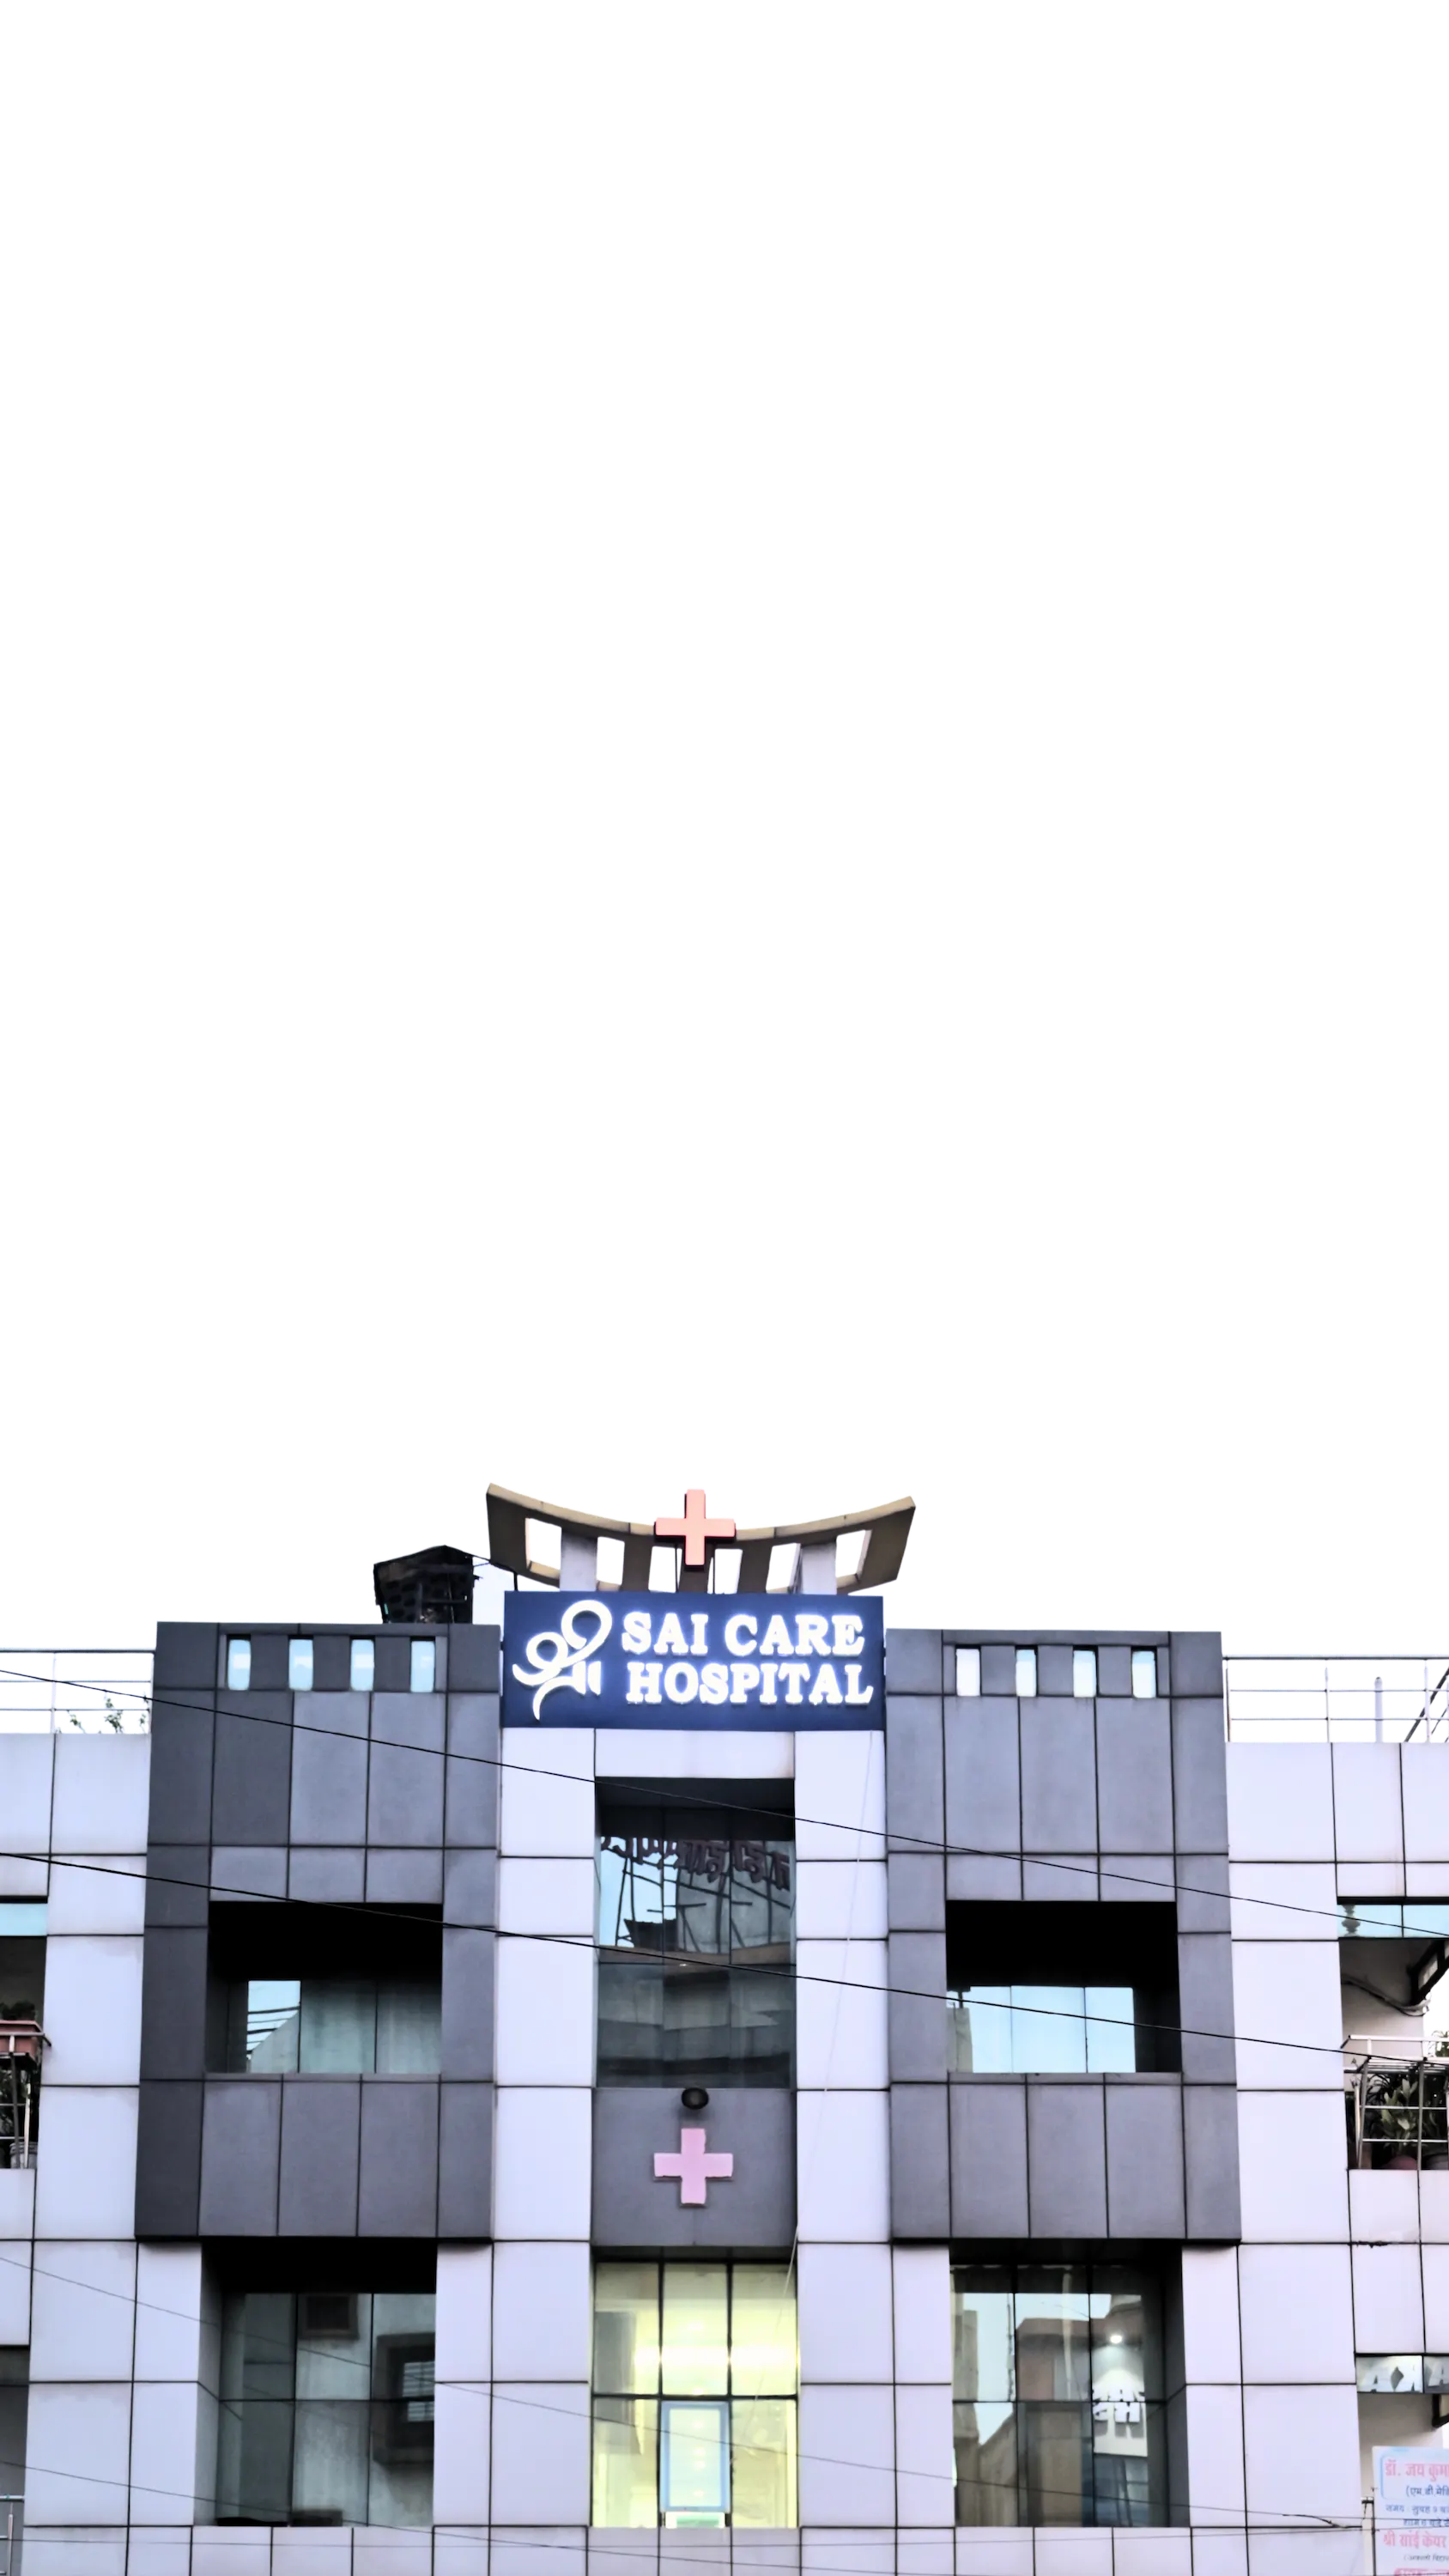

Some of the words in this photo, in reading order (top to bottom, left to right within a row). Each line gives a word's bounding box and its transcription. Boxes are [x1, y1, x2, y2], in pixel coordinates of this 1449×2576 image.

[621, 1612, 709, 1656] SAI
[724, 1613, 864, 1657] CARE
[626, 1662, 874, 1705] HOSPITAL
